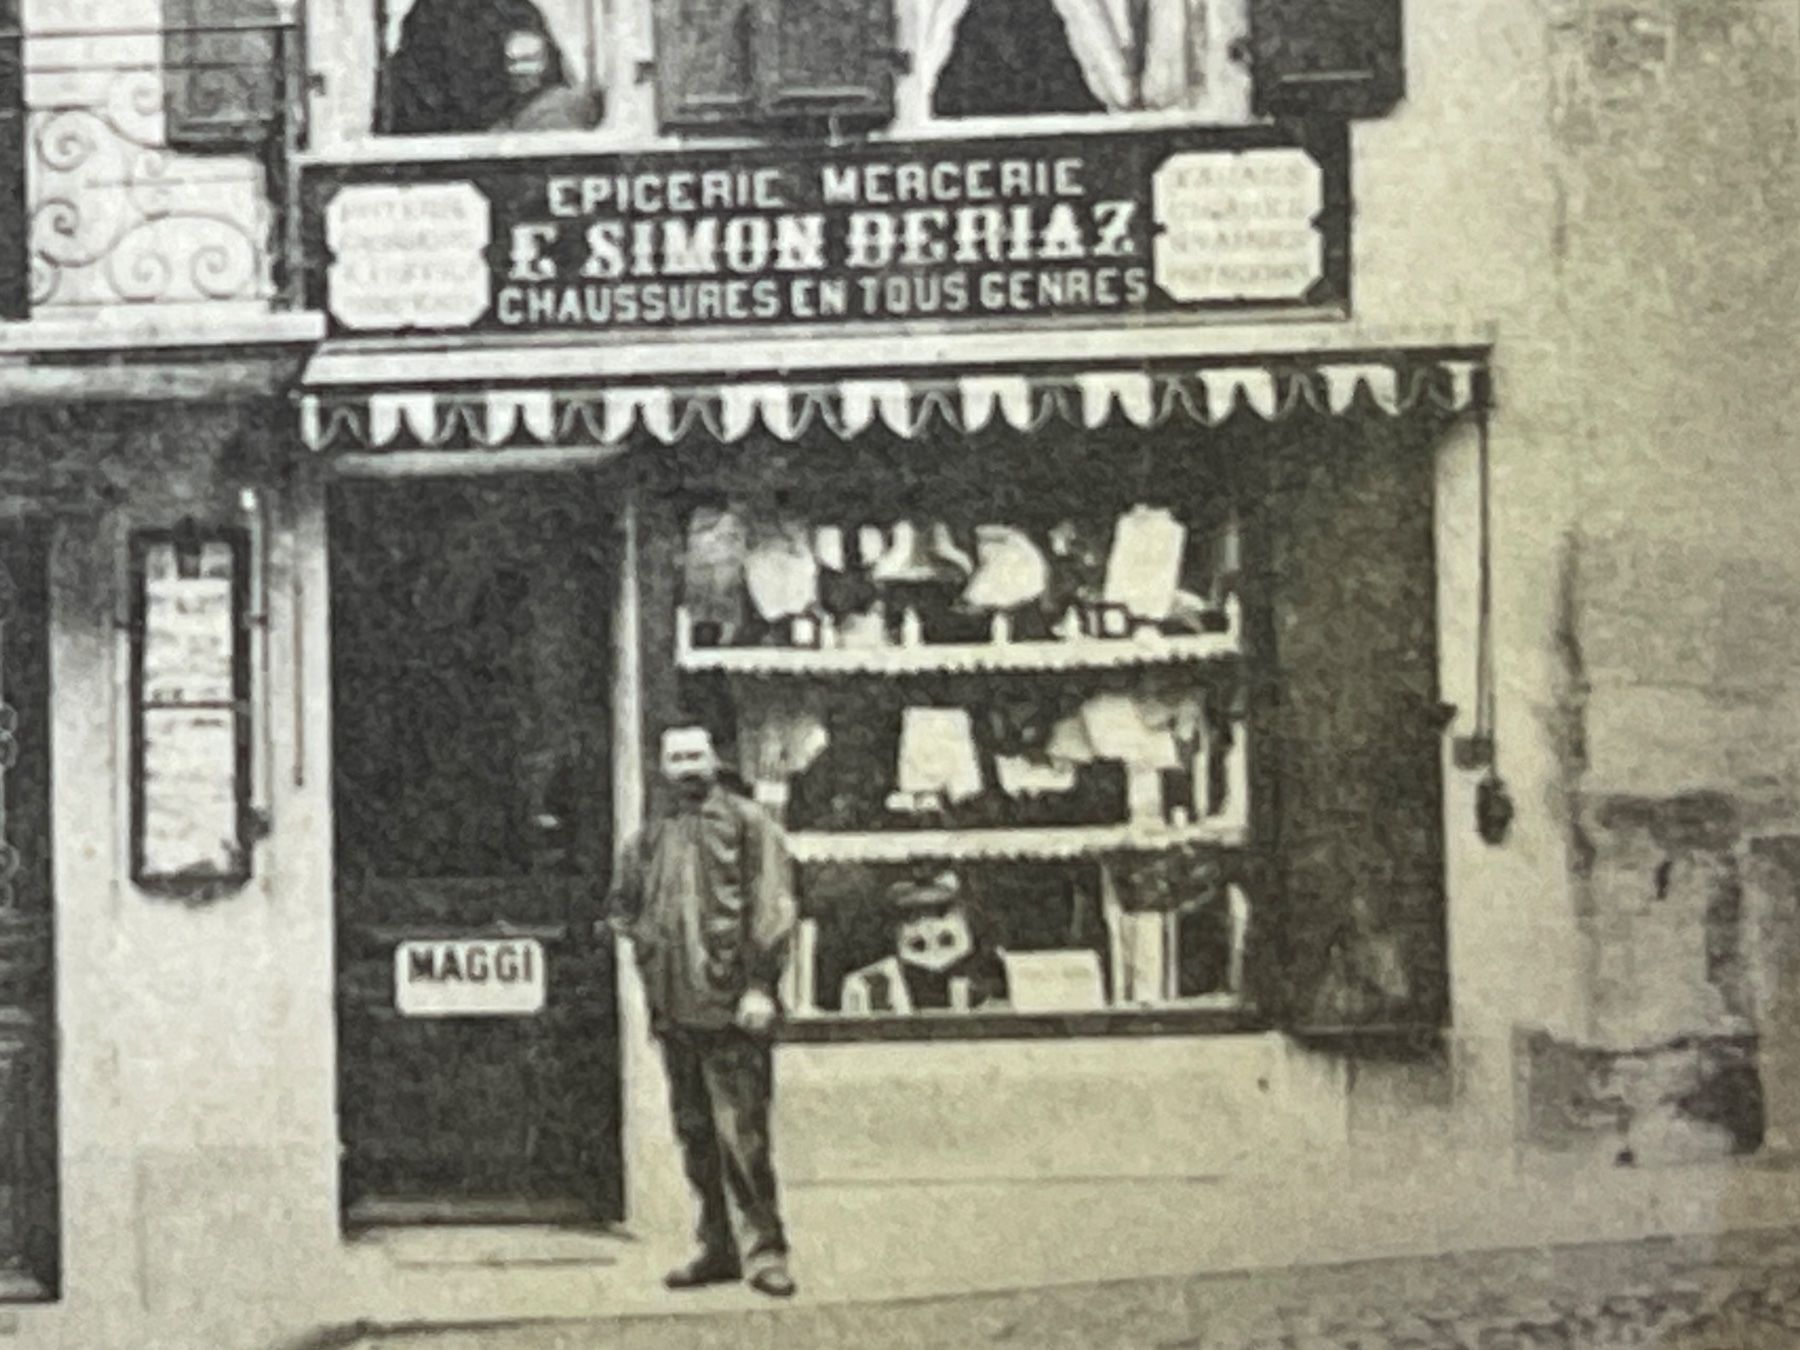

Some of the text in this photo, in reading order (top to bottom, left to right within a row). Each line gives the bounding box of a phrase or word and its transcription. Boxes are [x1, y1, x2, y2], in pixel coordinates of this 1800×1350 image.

[548, 158, 1085, 216] EPICERIE MERCERIE
[582, 214, 826, 278] SIMON
[497, 280, 780, 325] CHAUSSURES
[791, 279, 848, 317] EN
[857, 271, 969, 314] TOUS
[980, 267, 1148, 309] GENRES
[408, 943, 535, 984] MAGGI
